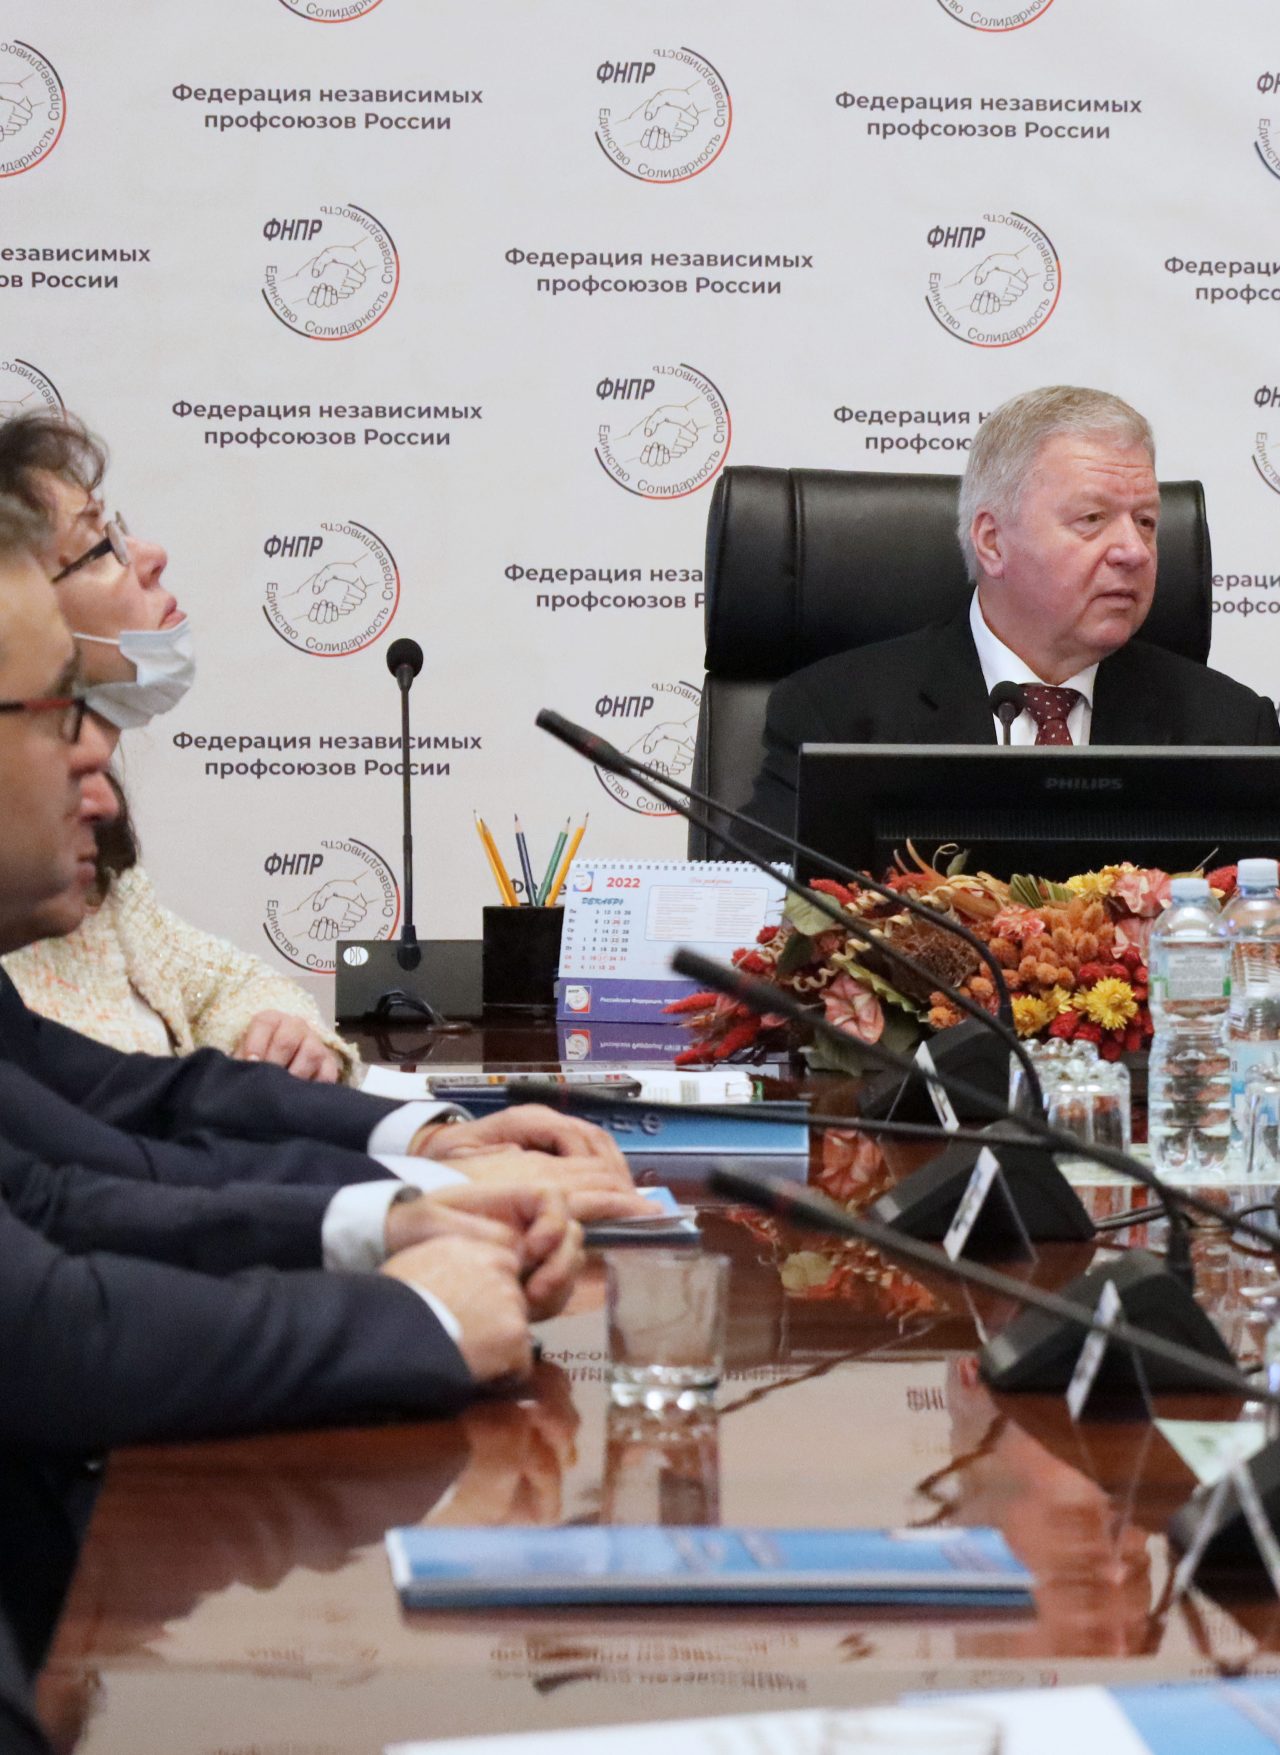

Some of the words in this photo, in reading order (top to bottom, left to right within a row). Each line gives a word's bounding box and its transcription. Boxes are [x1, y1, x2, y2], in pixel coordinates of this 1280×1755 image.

[306, 2, 372, 18] Солидарн
[970, 0, 1042, 29] Солидарно
[1, 43, 60, 121] Справедливос
[597, 61, 655, 83] ФНПР
[172, 84, 311, 105] Федерация
[320, 89, 482, 104] независимых
[653, 50, 727, 127] Справедливость
[836, 92, 971, 113] Федерация
[981, 98, 1141, 113] независимых
[205, 111, 356, 132] профсоюзов
[365, 113, 450, 130] России
[868, 119, 1016, 140] профсоюзов
[1025, 122, 1109, 139] России
[600, 108, 631, 166] Единство
[0, 128, 55, 173] идарность
[637, 133, 721, 178] Солидарность
[263, 218, 322, 241] ФНПР
[927, 225, 985, 248] ФНПР
[0, 248, 150, 262] езависимых
[320, 206, 395, 284] Справедливость
[983, 214, 1057, 291] Справедливость
[505, 248, 642, 269] Федерация
[651, 254, 813, 268] независимых
[32, 272, 118, 288] России
[537, 275, 687, 296] профсоюзов
[696, 277, 780, 294] России
[266, 265, 298, 323] Единство
[930, 272, 962, 329] Единство
[304, 290, 389, 336] Солидарность
[967, 297, 1051, 342] Солидарность
[1, 361, 59, 416] аведливос
[596, 377, 655, 400] ФНПР
[172, 400, 310, 421] Федерация
[320, 405, 482, 419] независимых
[652, 366, 726, 443] Справедливость
[834, 406, 969, 427] Федерация
[205, 427, 356, 448] профсоюзов
[365, 429, 449, 446] России
[866, 433, 972, 454] профсою
[599, 424, 630, 482] Единство
[636, 449, 720, 494] Солидарность
[264, 535, 323, 558] ФНПР
[321, 523, 396, 601] Справедливость
[505, 564, 641, 585] Федерация
[267, 582, 299, 640] Единство
[537, 591, 686, 612] профсоюзов
[305, 607, 390, 653] Солидарность
[595, 695, 654, 718] ФНПР
[173, 732, 310, 752] Федерация
[205, 758, 356, 779] профсоюзов
[1045, 778, 1123, 790] PHILIPS
[264, 853, 323, 875] ФНПР
[607, 877, 641, 888] 2022
[267, 899, 299, 957] Единство
[321, 840, 396, 918] Справедливость
